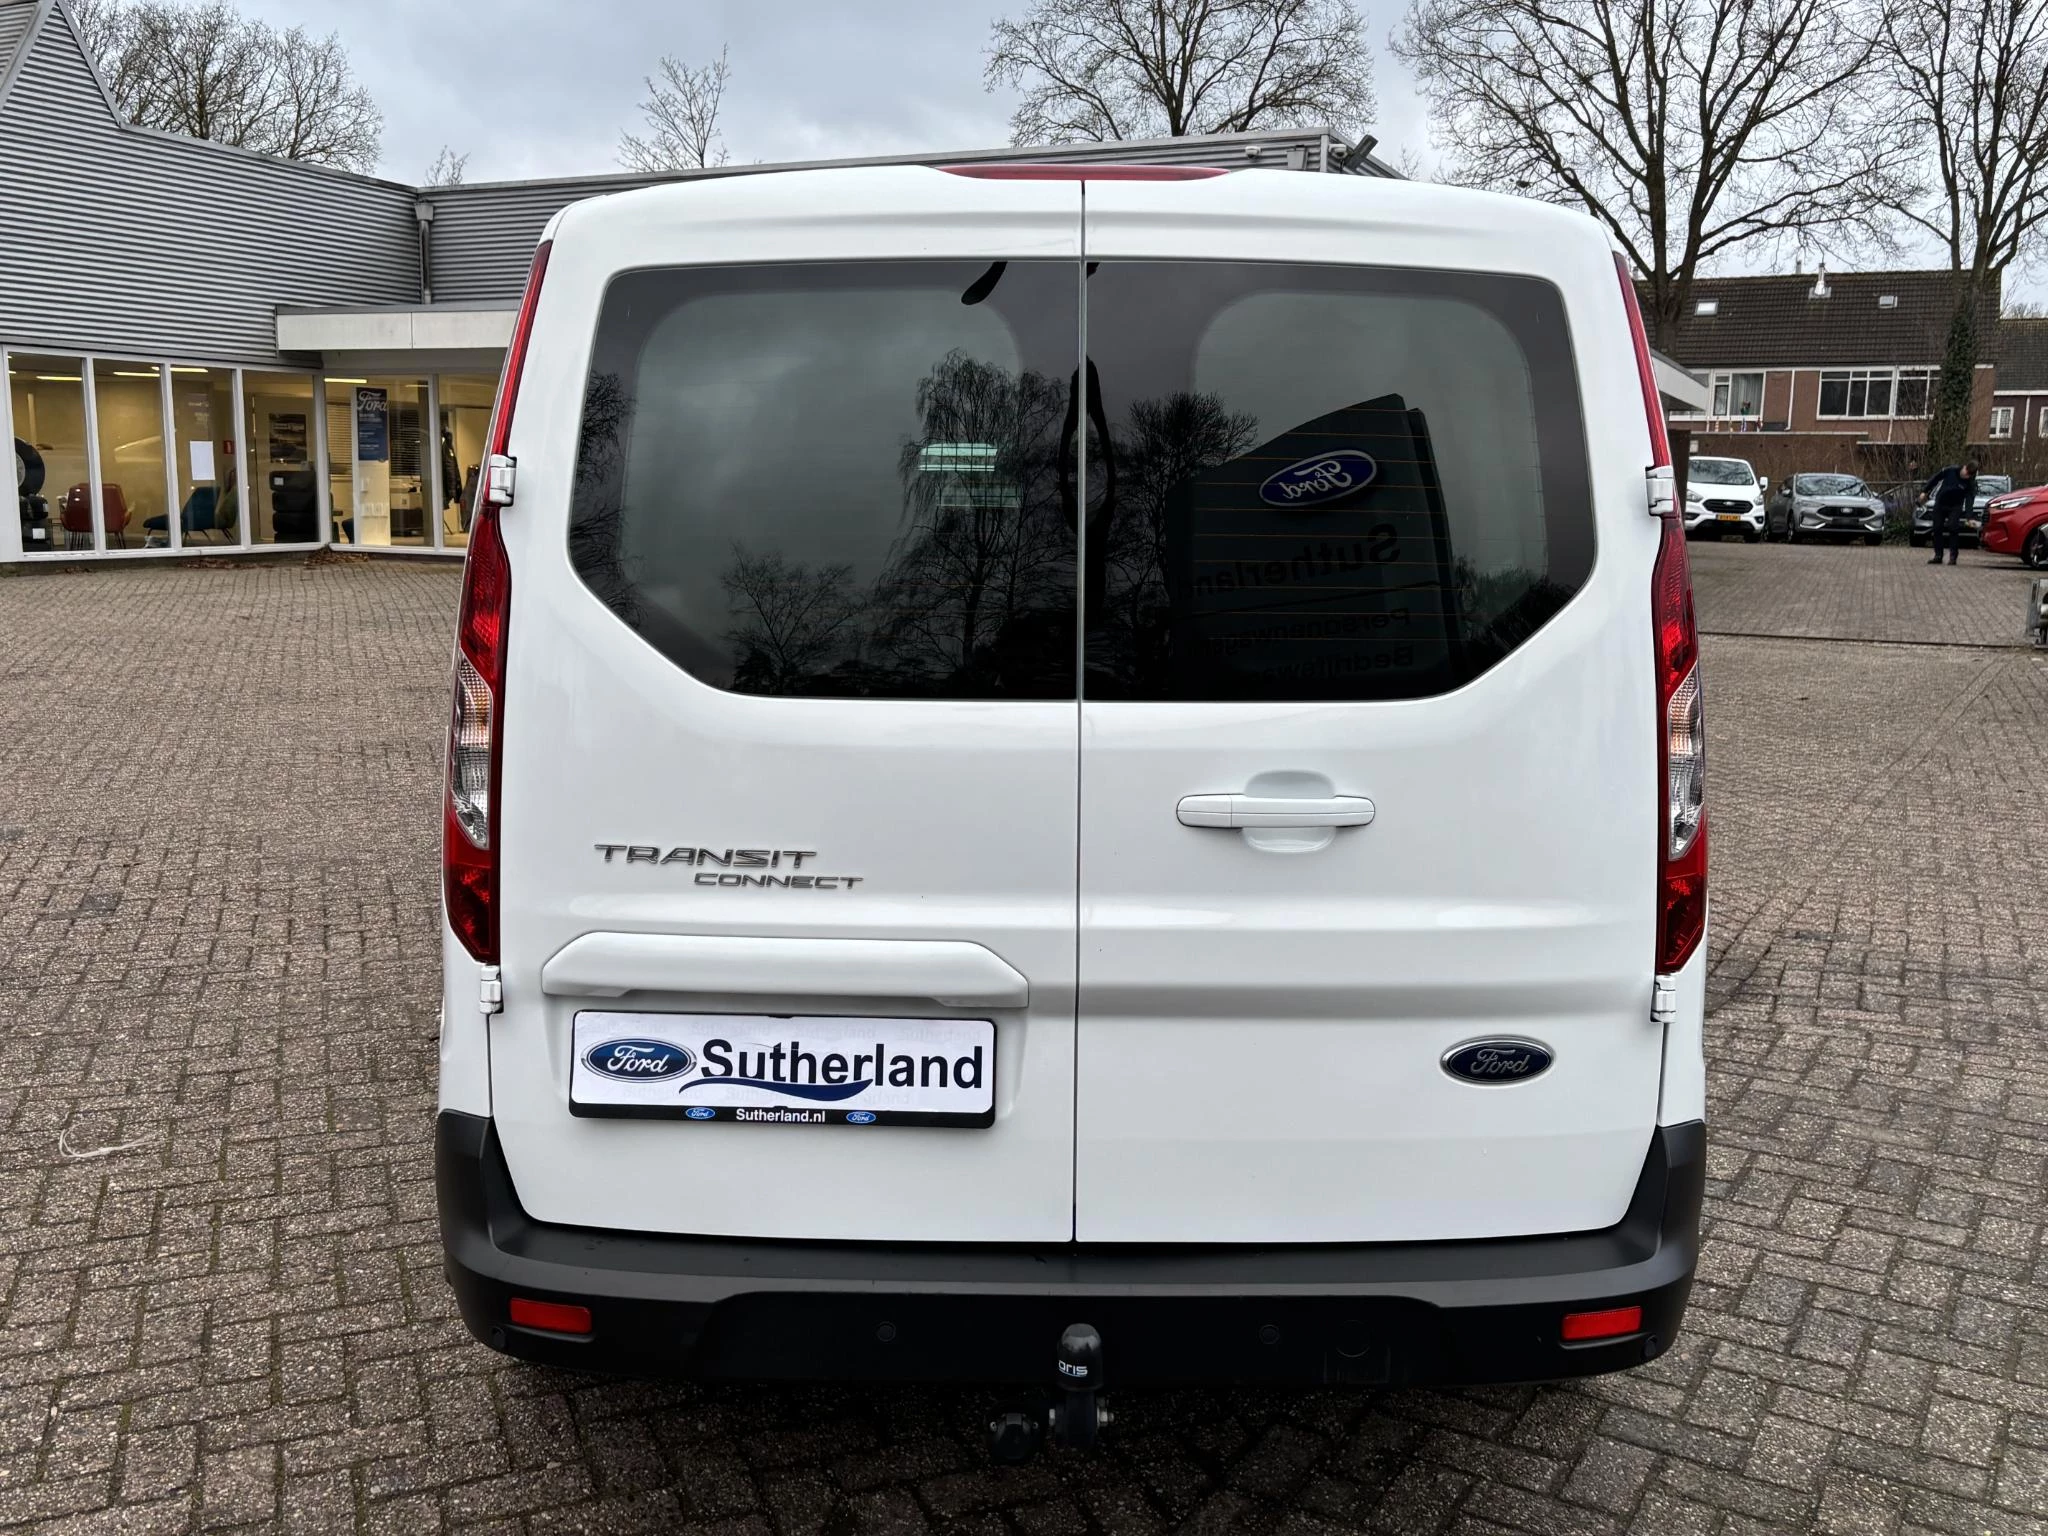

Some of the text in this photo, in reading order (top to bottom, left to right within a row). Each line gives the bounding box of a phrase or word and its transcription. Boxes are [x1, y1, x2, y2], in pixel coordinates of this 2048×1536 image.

[357, 391, 387, 411] Ford
[594, 844, 816, 868] TRANSIT
[694, 872, 863, 889] CONNECT
[606, 1045, 670, 1073] Ford
[700, 1038, 983, 1089] Sutherland
[1470, 1048, 1531, 1074] Ford
[735, 1108, 826, 1123] Sutherland.nl
